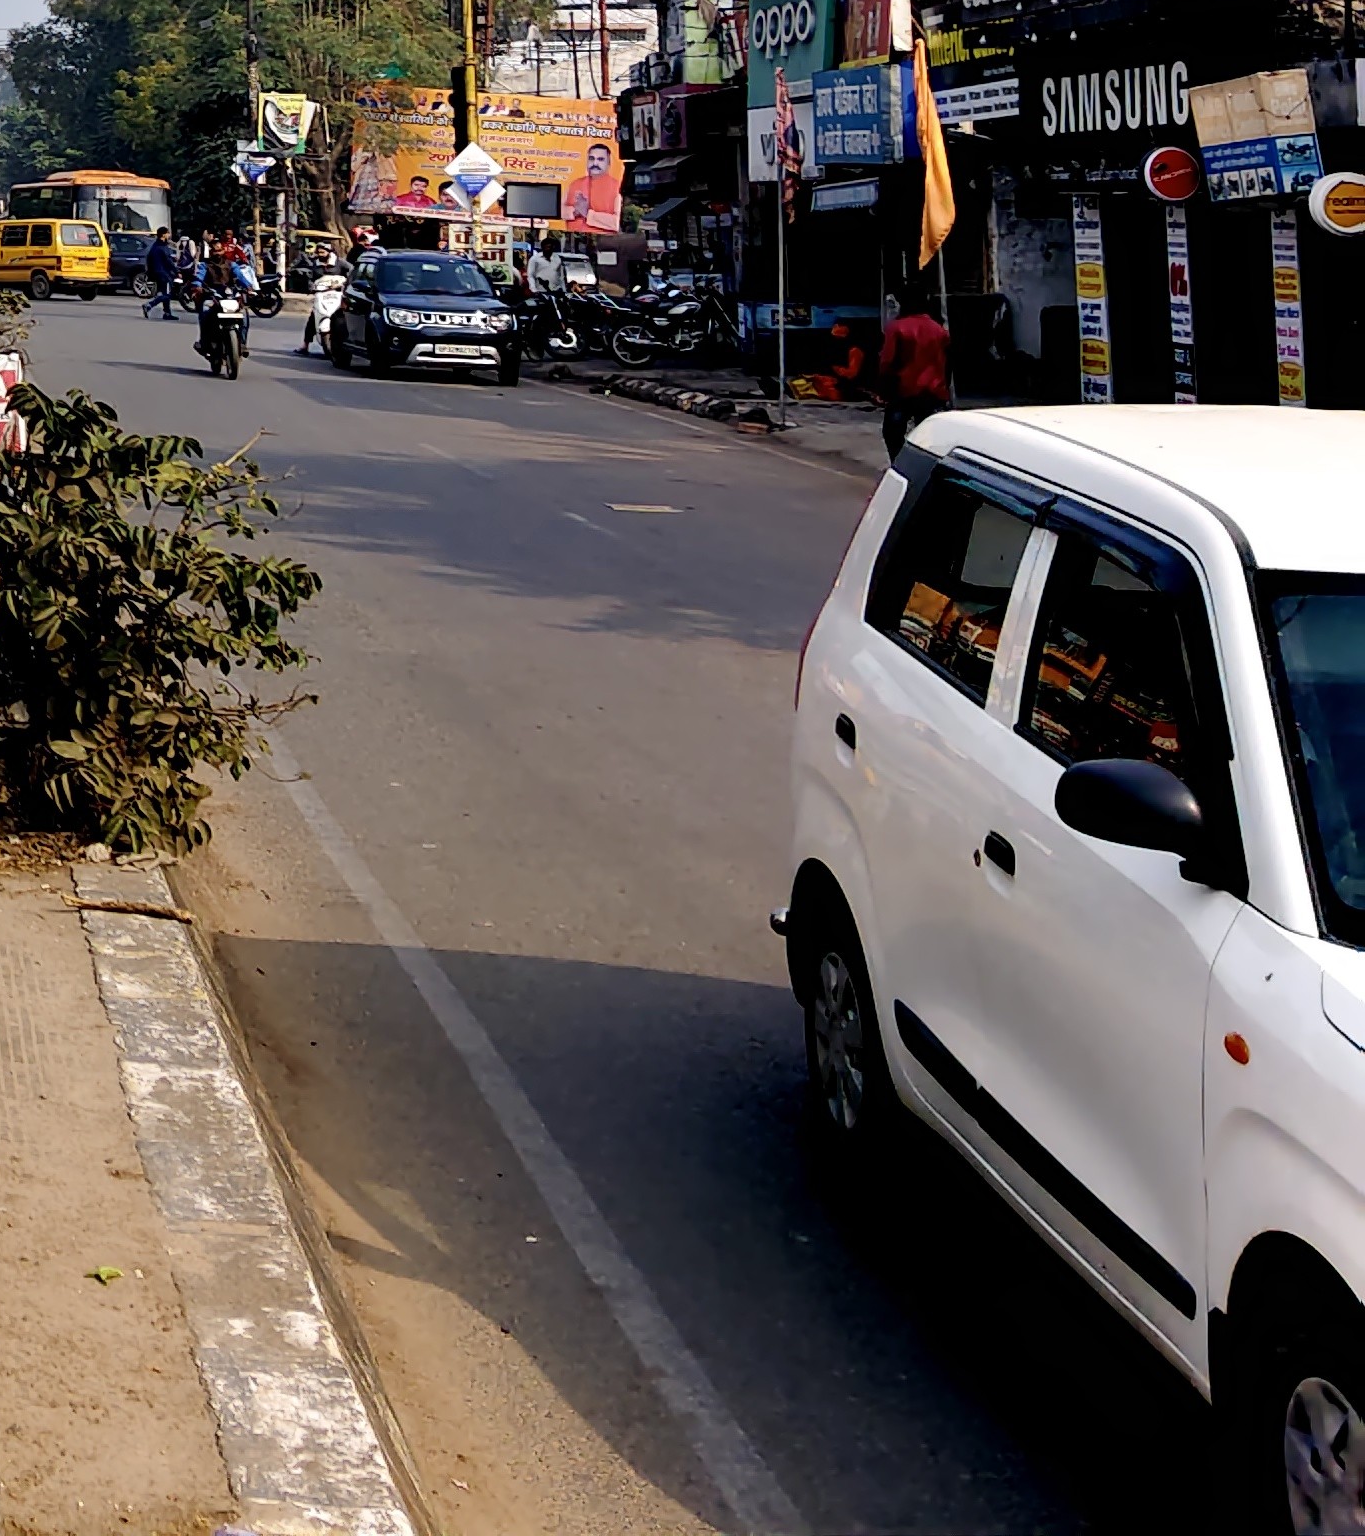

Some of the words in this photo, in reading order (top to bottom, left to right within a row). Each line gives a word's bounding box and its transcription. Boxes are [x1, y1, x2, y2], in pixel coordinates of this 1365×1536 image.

[753, 0, 815, 59] oppo
[1042, 60, 1189, 137] SAMSUNG
[504, 157, 537, 170] सिंह
